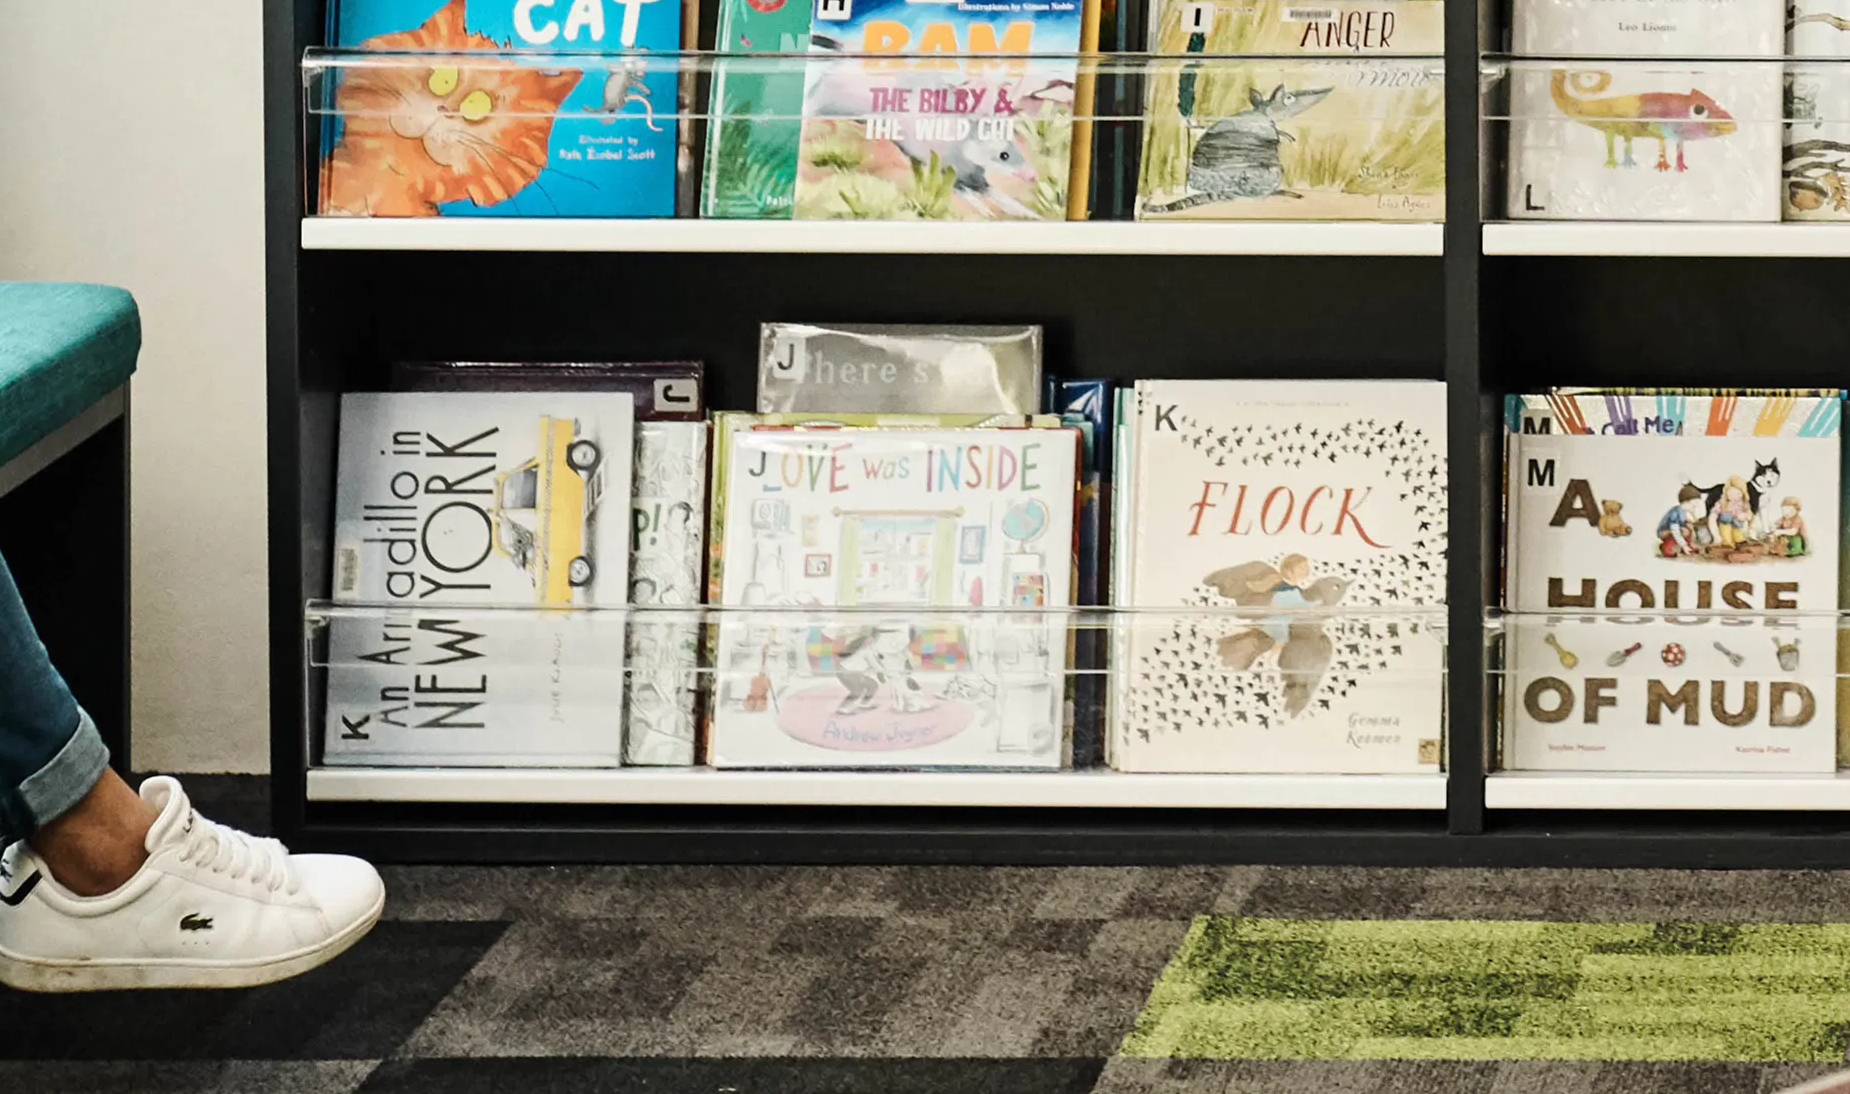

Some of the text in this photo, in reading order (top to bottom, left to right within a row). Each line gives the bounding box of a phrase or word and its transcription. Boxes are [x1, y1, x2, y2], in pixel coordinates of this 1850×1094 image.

[1619, 22, 1638, 32] Leo
[918, 86, 985, 114] BILBY
[1526, 184, 1545, 211] L
[776, 344, 796, 371] J
[925, 442, 1042, 493] INSIDE
[1186, 480, 1394, 549] FLOCK
[1549, 478, 1602, 527] A
[411, 427, 500, 729] NEW YORK
[1523, 676, 1817, 729] OF MUD
